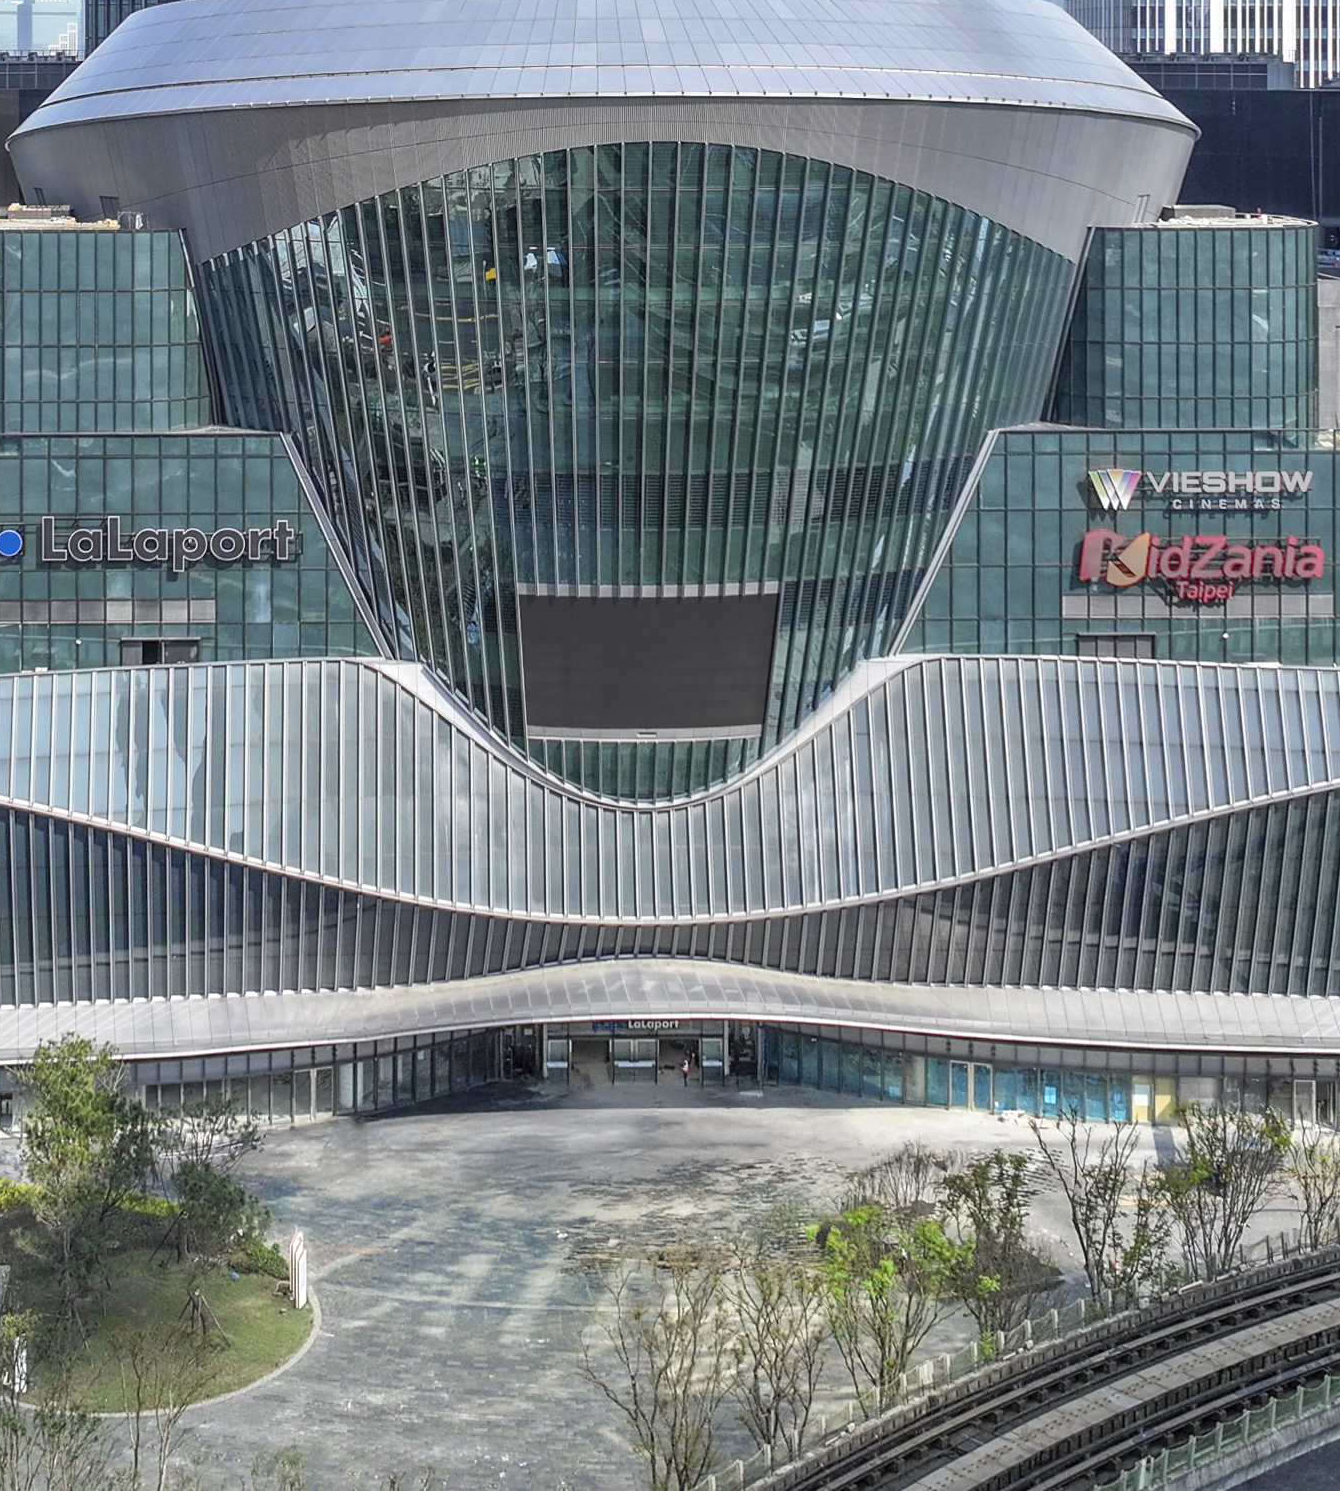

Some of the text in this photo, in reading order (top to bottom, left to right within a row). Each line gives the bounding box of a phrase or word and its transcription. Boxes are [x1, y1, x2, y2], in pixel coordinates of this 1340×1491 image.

[1146, 471, 1313, 493] VIESHOW
[1172, 498, 1281, 509] CINEMAS
[42, 516, 293, 572] LaLaport
[1079, 529, 1325, 587] KidZania
[1177, 581, 1234, 601] Taipei
[628, 1020, 679, 1031] LaLaport
